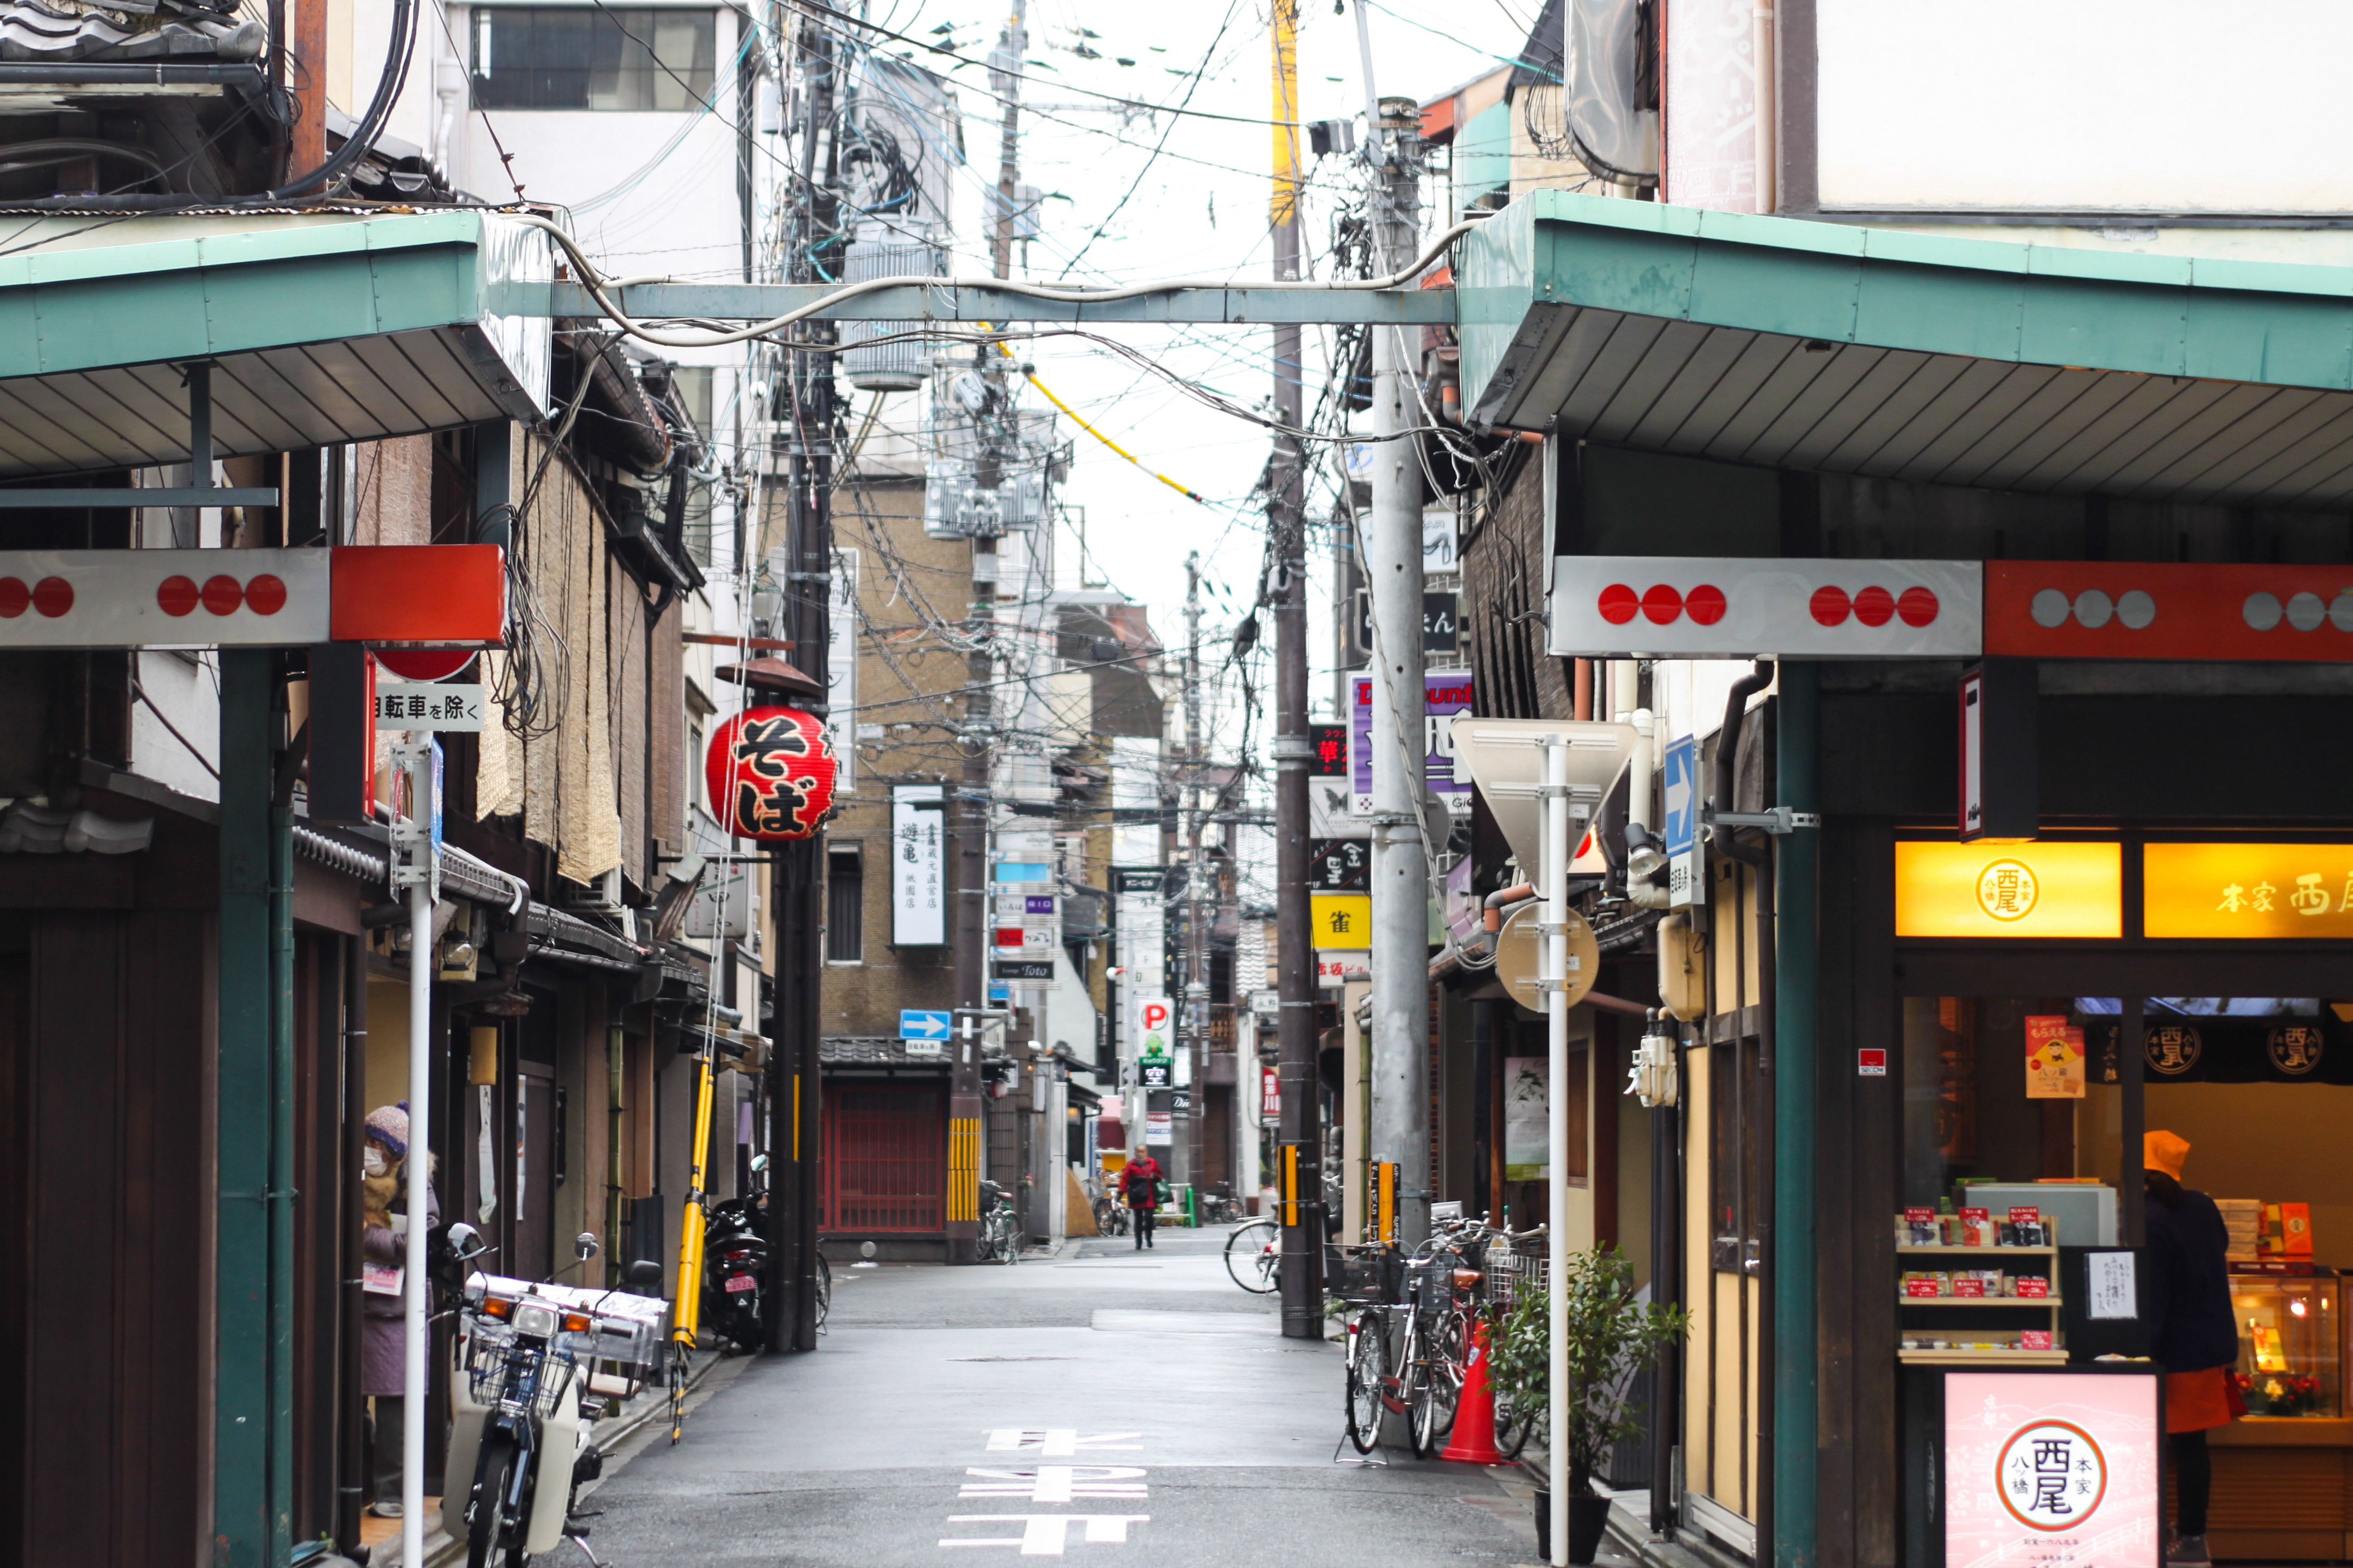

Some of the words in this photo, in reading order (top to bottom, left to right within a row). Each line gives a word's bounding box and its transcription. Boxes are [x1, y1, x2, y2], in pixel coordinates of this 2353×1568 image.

[733, 717, 814, 833] そば
[1994, 870, 2019, 912] 西尾
[2216, 881, 2276, 912] 本家
[1329, 910, 1351, 933] 雀
[1022, 965, 1047, 976] Toto
[1144, 1005, 1166, 1030] P
[1145, 1066, 1166, 1085] 空
[2028, 1439, 2073, 1514] 西尾
[2074, 1457, 2092, 1494] 本家
